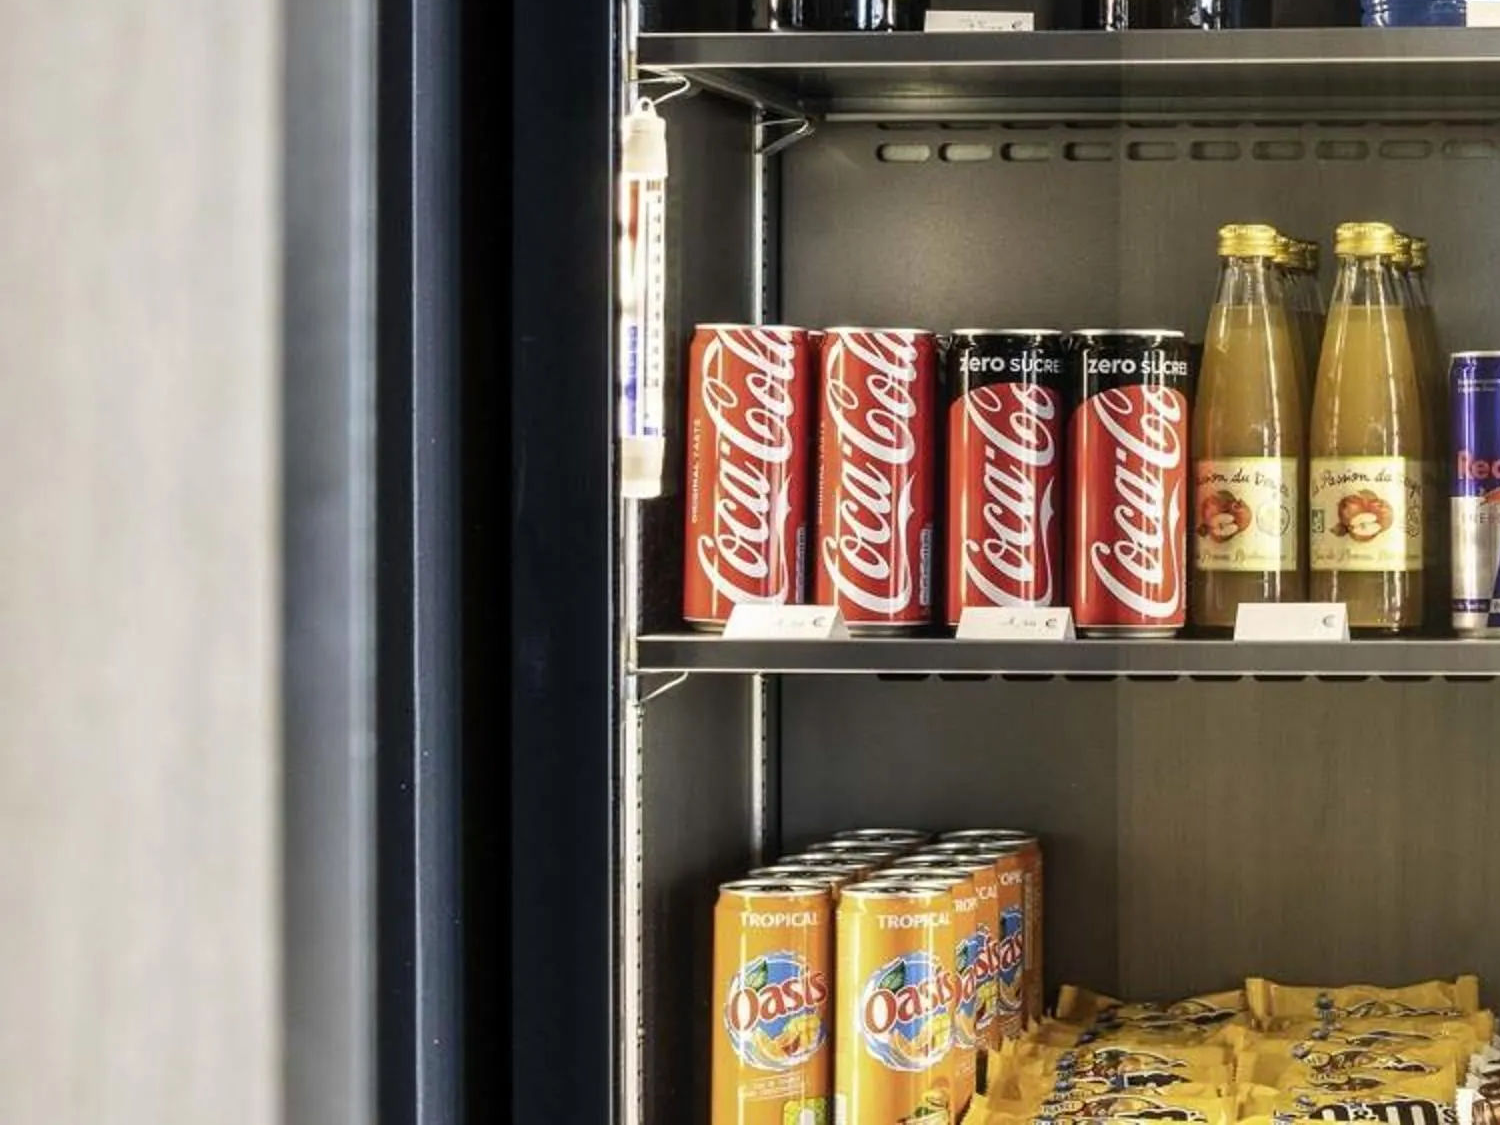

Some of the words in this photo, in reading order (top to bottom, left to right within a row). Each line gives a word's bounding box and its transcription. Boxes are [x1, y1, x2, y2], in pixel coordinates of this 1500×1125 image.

[959, 355, 1005, 373] zero
[1088, 358, 1136, 375] zero
[697, 330, 795, 606] Coca-Cola
[823, 332, 918, 614] Coca-Cola
[963, 382, 1056, 607] Coca-Co
[1091, 384, 1182, 619] Coca-Co
[730, 971, 828, 1031] Oasis
[865, 971, 957, 1034] Oasis
